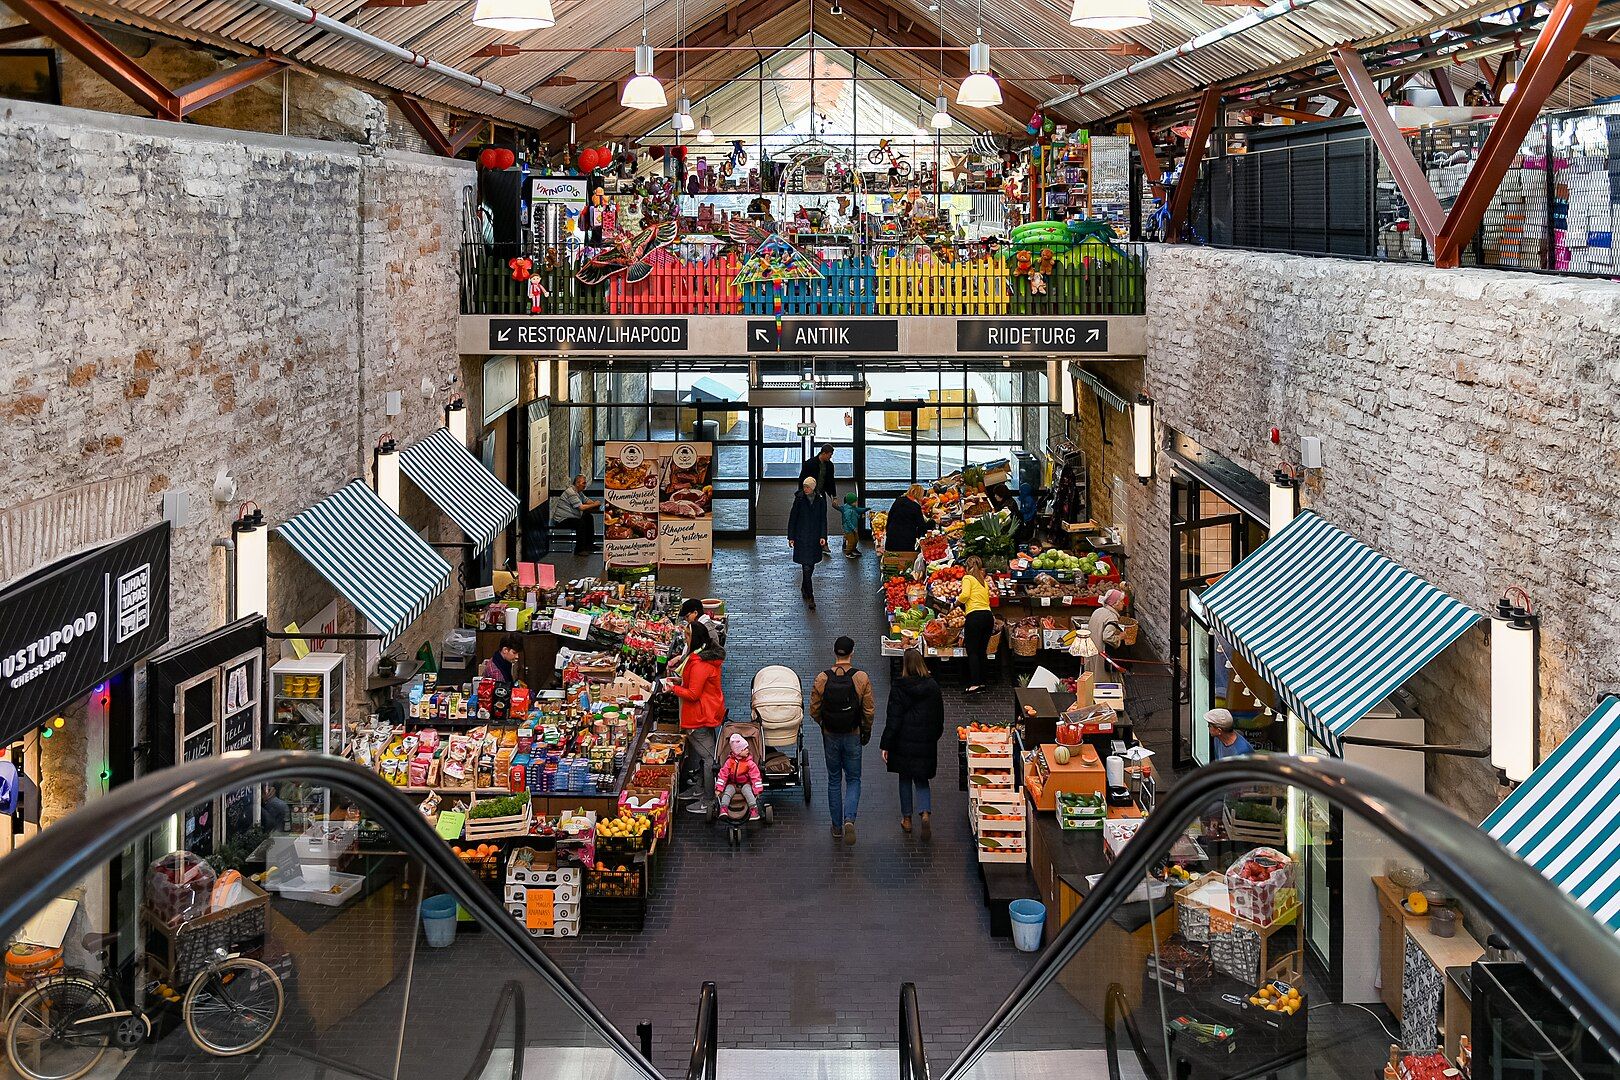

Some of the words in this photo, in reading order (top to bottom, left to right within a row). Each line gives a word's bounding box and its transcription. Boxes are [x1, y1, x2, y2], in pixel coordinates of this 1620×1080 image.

[536, 183, 580, 197] VIKINGTOYS
[517, 325, 681, 344] RESTORAN/LIHAPOOD
[795, 327, 850, 345] ANTIIK
[987, 327, 1076, 345] RIIDETURG
[121, 586, 147, 610] TAPAS
[0, 611, 98, 679] USTUPOOD
[10, 664, 44, 689] CHEESE
[43, 651, 67, 672] SHOP
